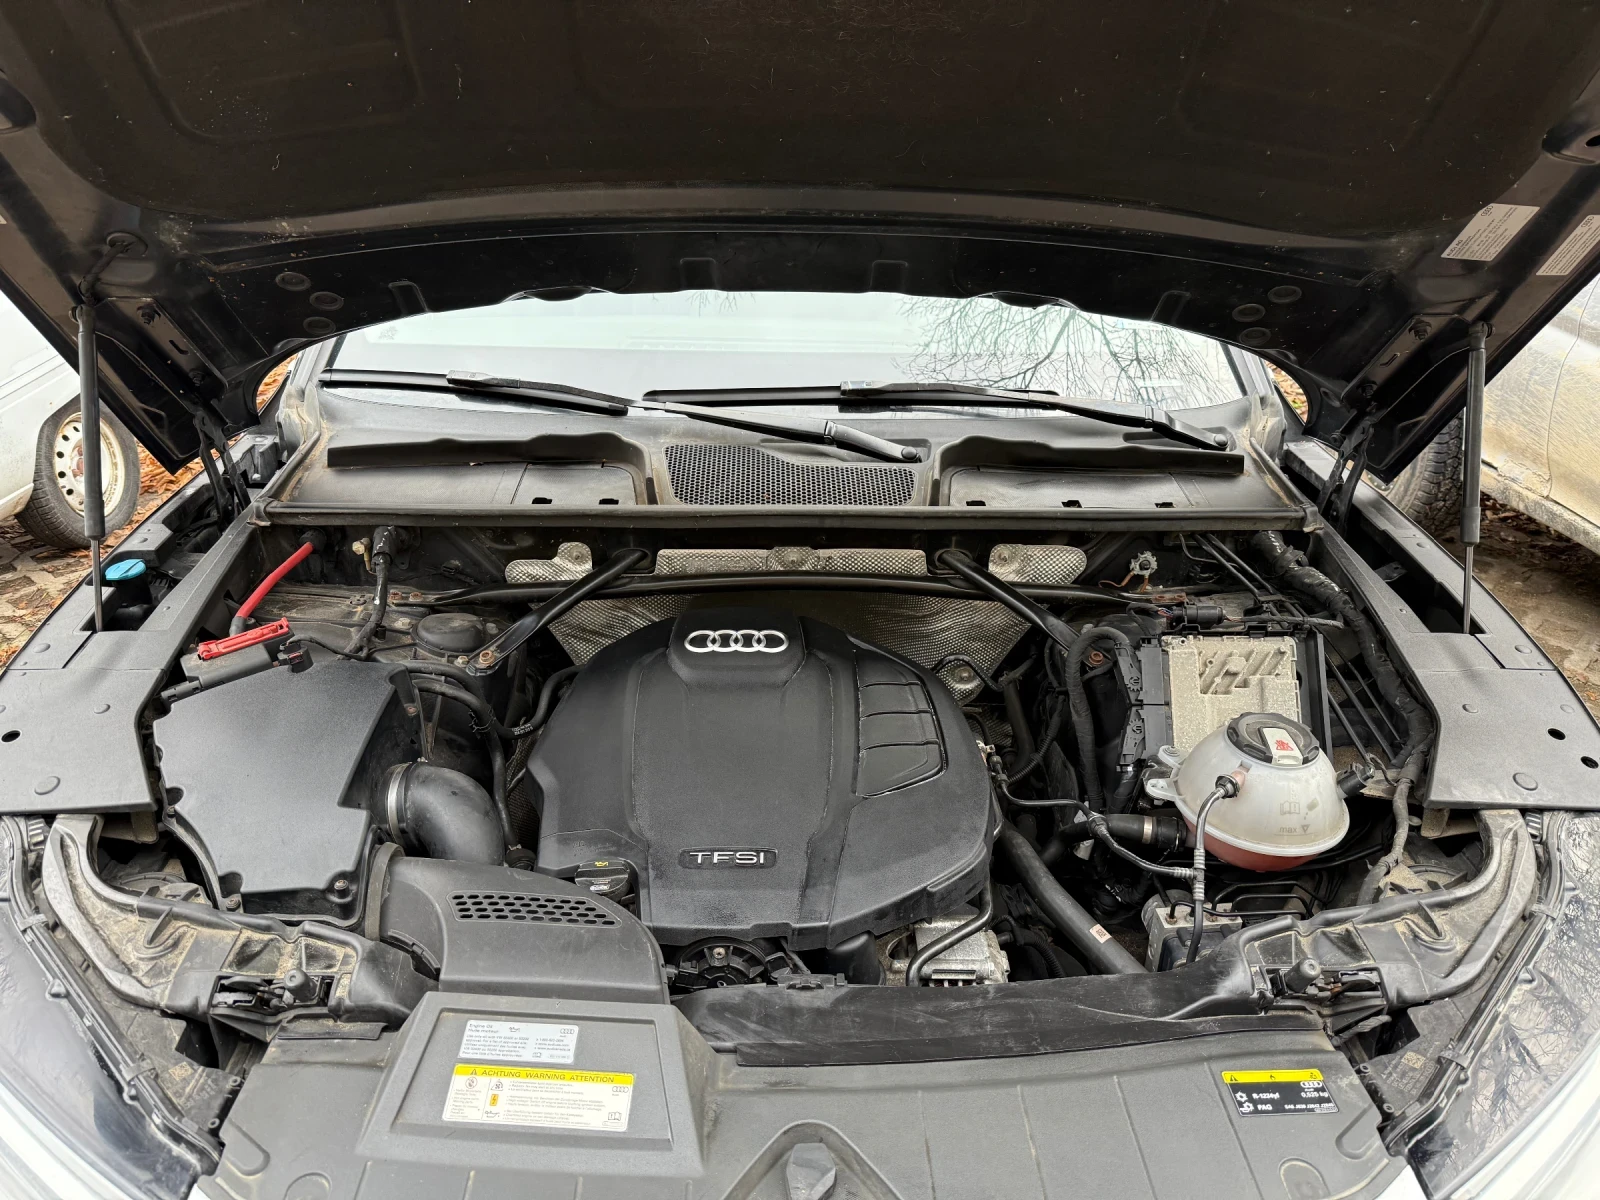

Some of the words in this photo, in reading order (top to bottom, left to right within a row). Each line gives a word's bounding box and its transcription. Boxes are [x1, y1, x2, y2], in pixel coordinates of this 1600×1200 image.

[1279, 826, 1298, 834] max
[690, 851, 765, 865] TFSI
[481, 1069, 521, 1079] ACHTUNG
[525, 1072, 566, 1081] WARNING
[569, 1074, 615, 1083] ATTENTION
